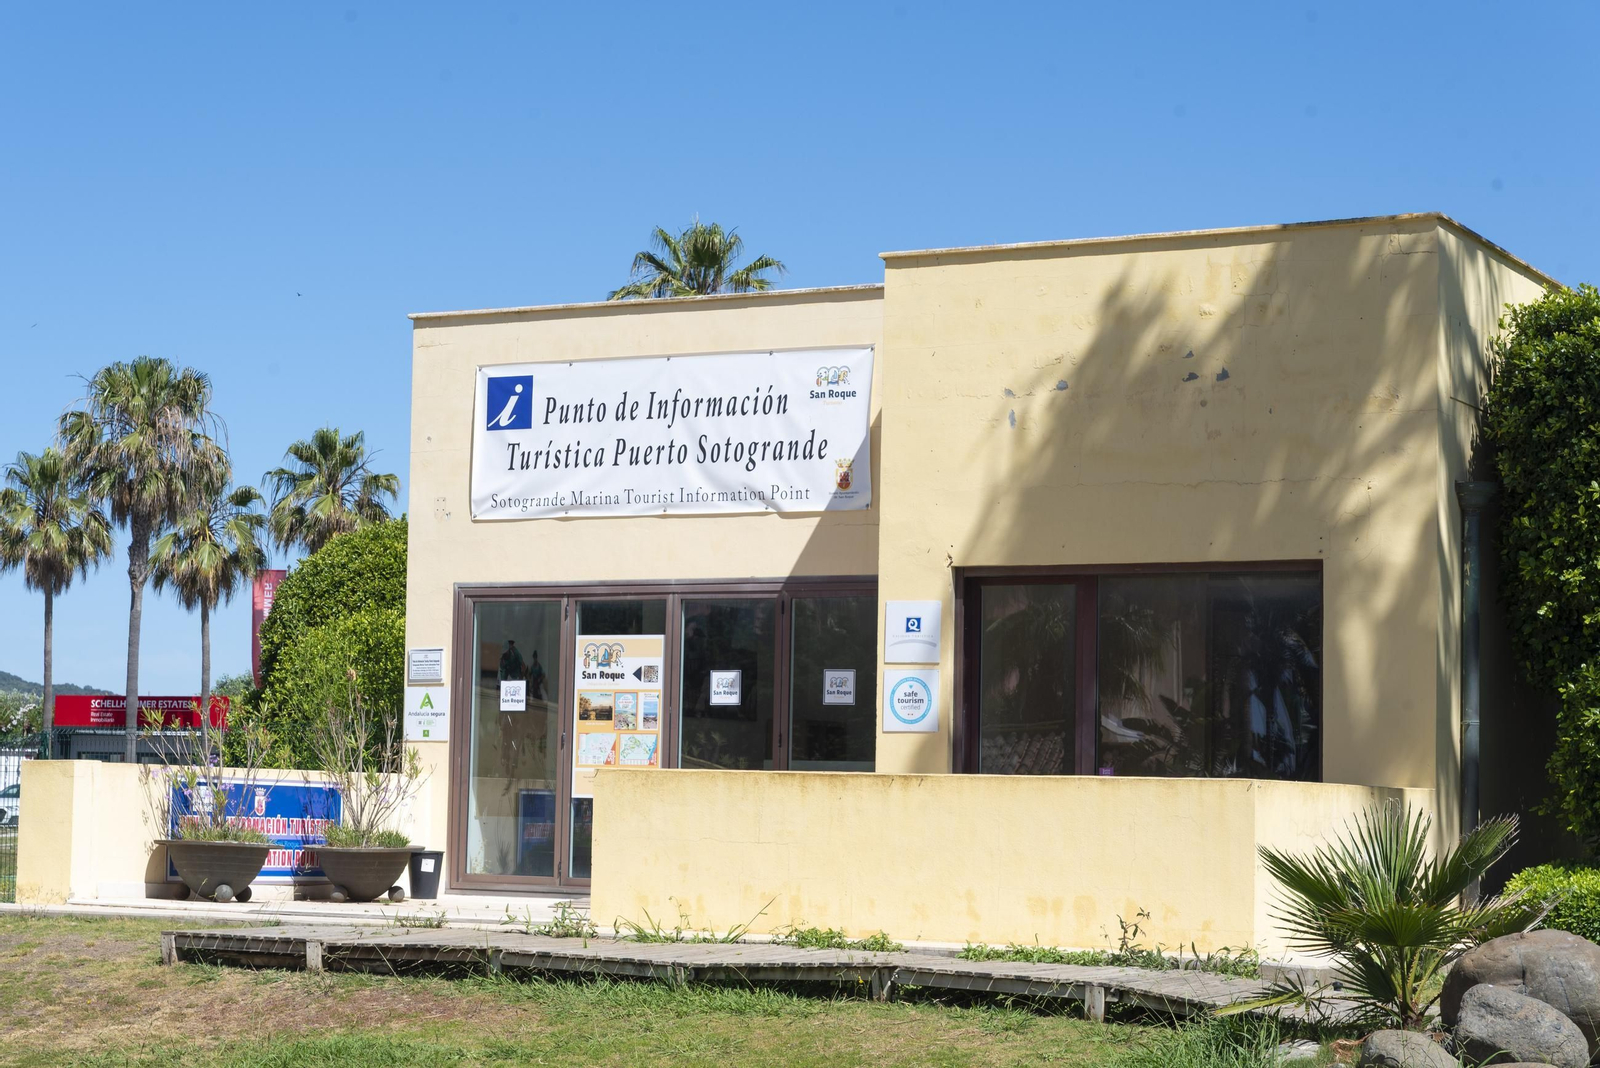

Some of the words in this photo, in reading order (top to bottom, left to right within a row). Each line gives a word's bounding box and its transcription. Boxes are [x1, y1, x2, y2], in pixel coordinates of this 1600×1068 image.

[543, 396, 607, 425] Punto
[615, 391, 639, 422] de
[646, 385, 788, 429] Información
[809, 390, 826, 399] San
[828, 389, 857, 401] Roque
[507, 440, 605, 471] Turística
[612, 438, 688, 467] Puerto
[697, 428, 828, 472] Sotogrande
[491, 491, 566, 512] Sotogrande
[570, 490, 620, 506] Marina
[623, 488, 675, 505] Tourist
[679, 486, 766, 503] Information
[770, 484, 810, 501] Point
[582, 670, 597, 679] San
[600, 670, 625, 682] Roque
